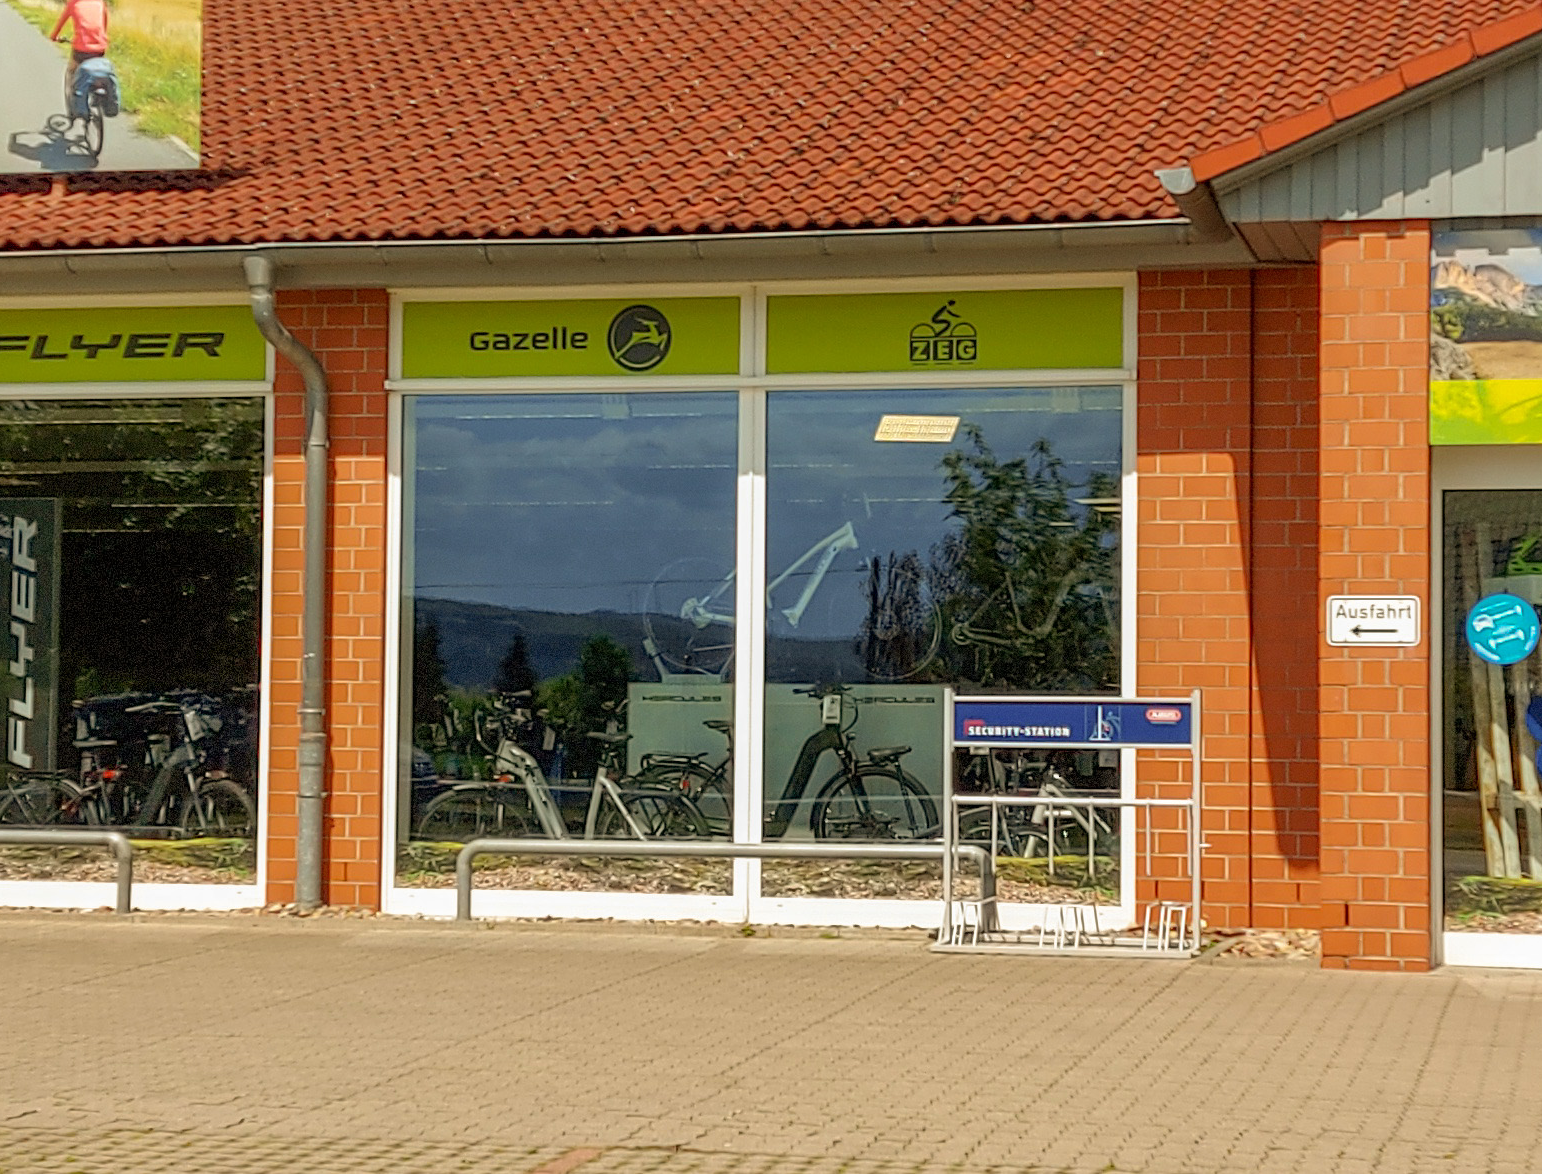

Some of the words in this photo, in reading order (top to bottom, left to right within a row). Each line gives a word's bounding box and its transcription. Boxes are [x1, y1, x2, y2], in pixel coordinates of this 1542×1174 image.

[470, 326, 589, 351] Gazelle
[911, 340, 976, 361] ZEG
[1335, 604, 1412, 619] Ausfahrt
[8, 516, 38, 769] FLYER
